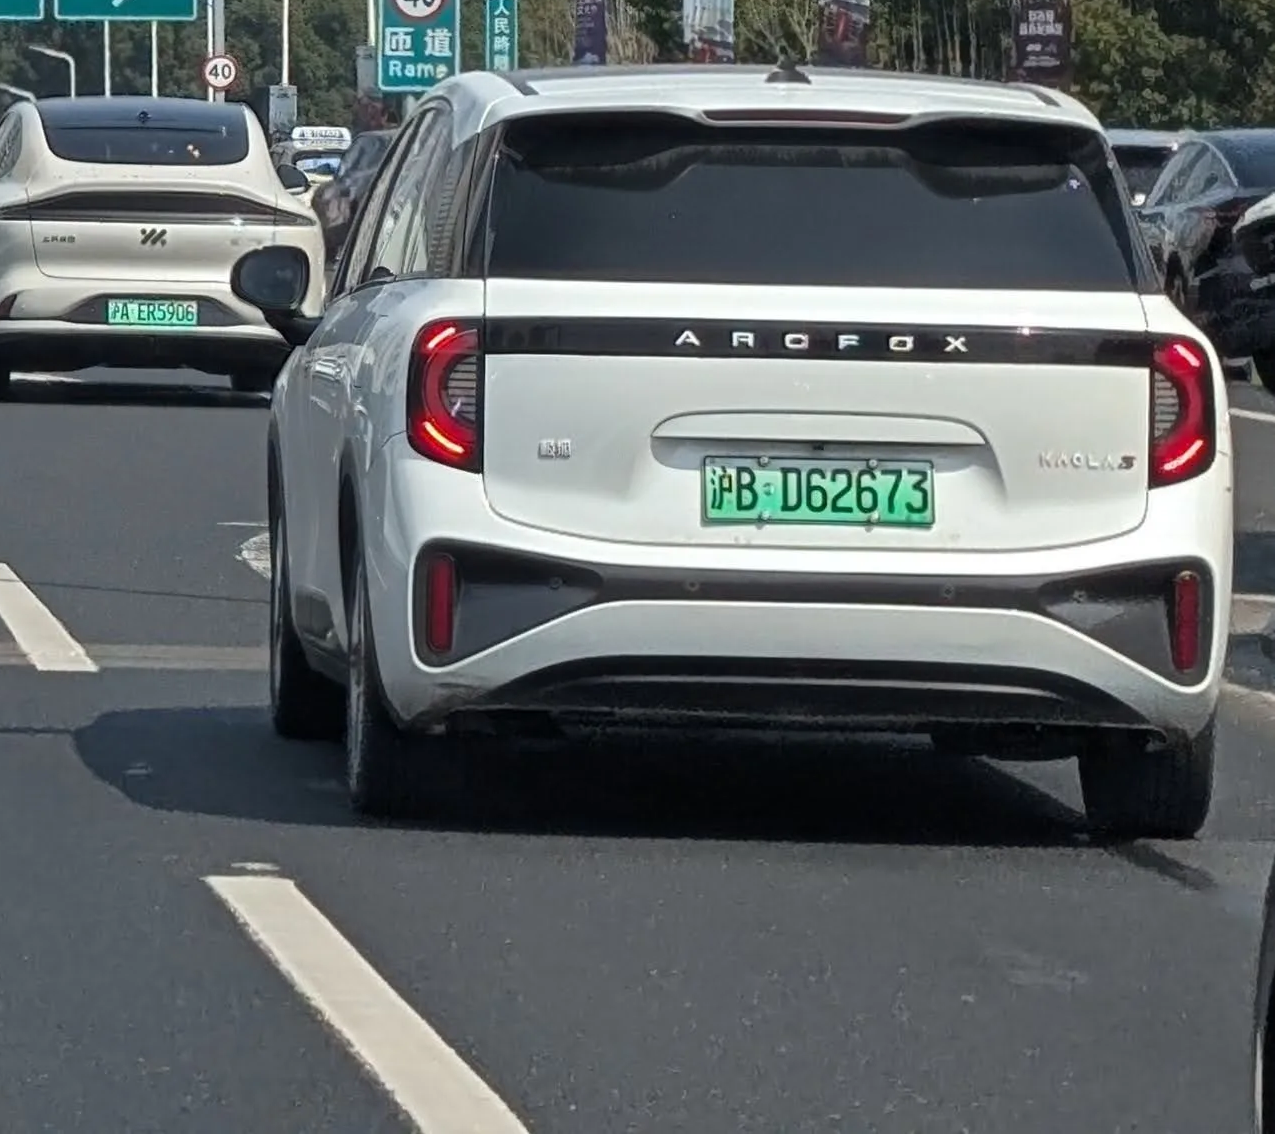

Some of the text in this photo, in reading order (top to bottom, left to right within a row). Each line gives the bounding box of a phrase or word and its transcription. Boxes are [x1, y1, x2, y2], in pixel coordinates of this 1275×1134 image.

[384, 27, 453, 57] 匝道
[208, 64, 232, 79] 40
[675, 329, 969, 353] ARCFOX
